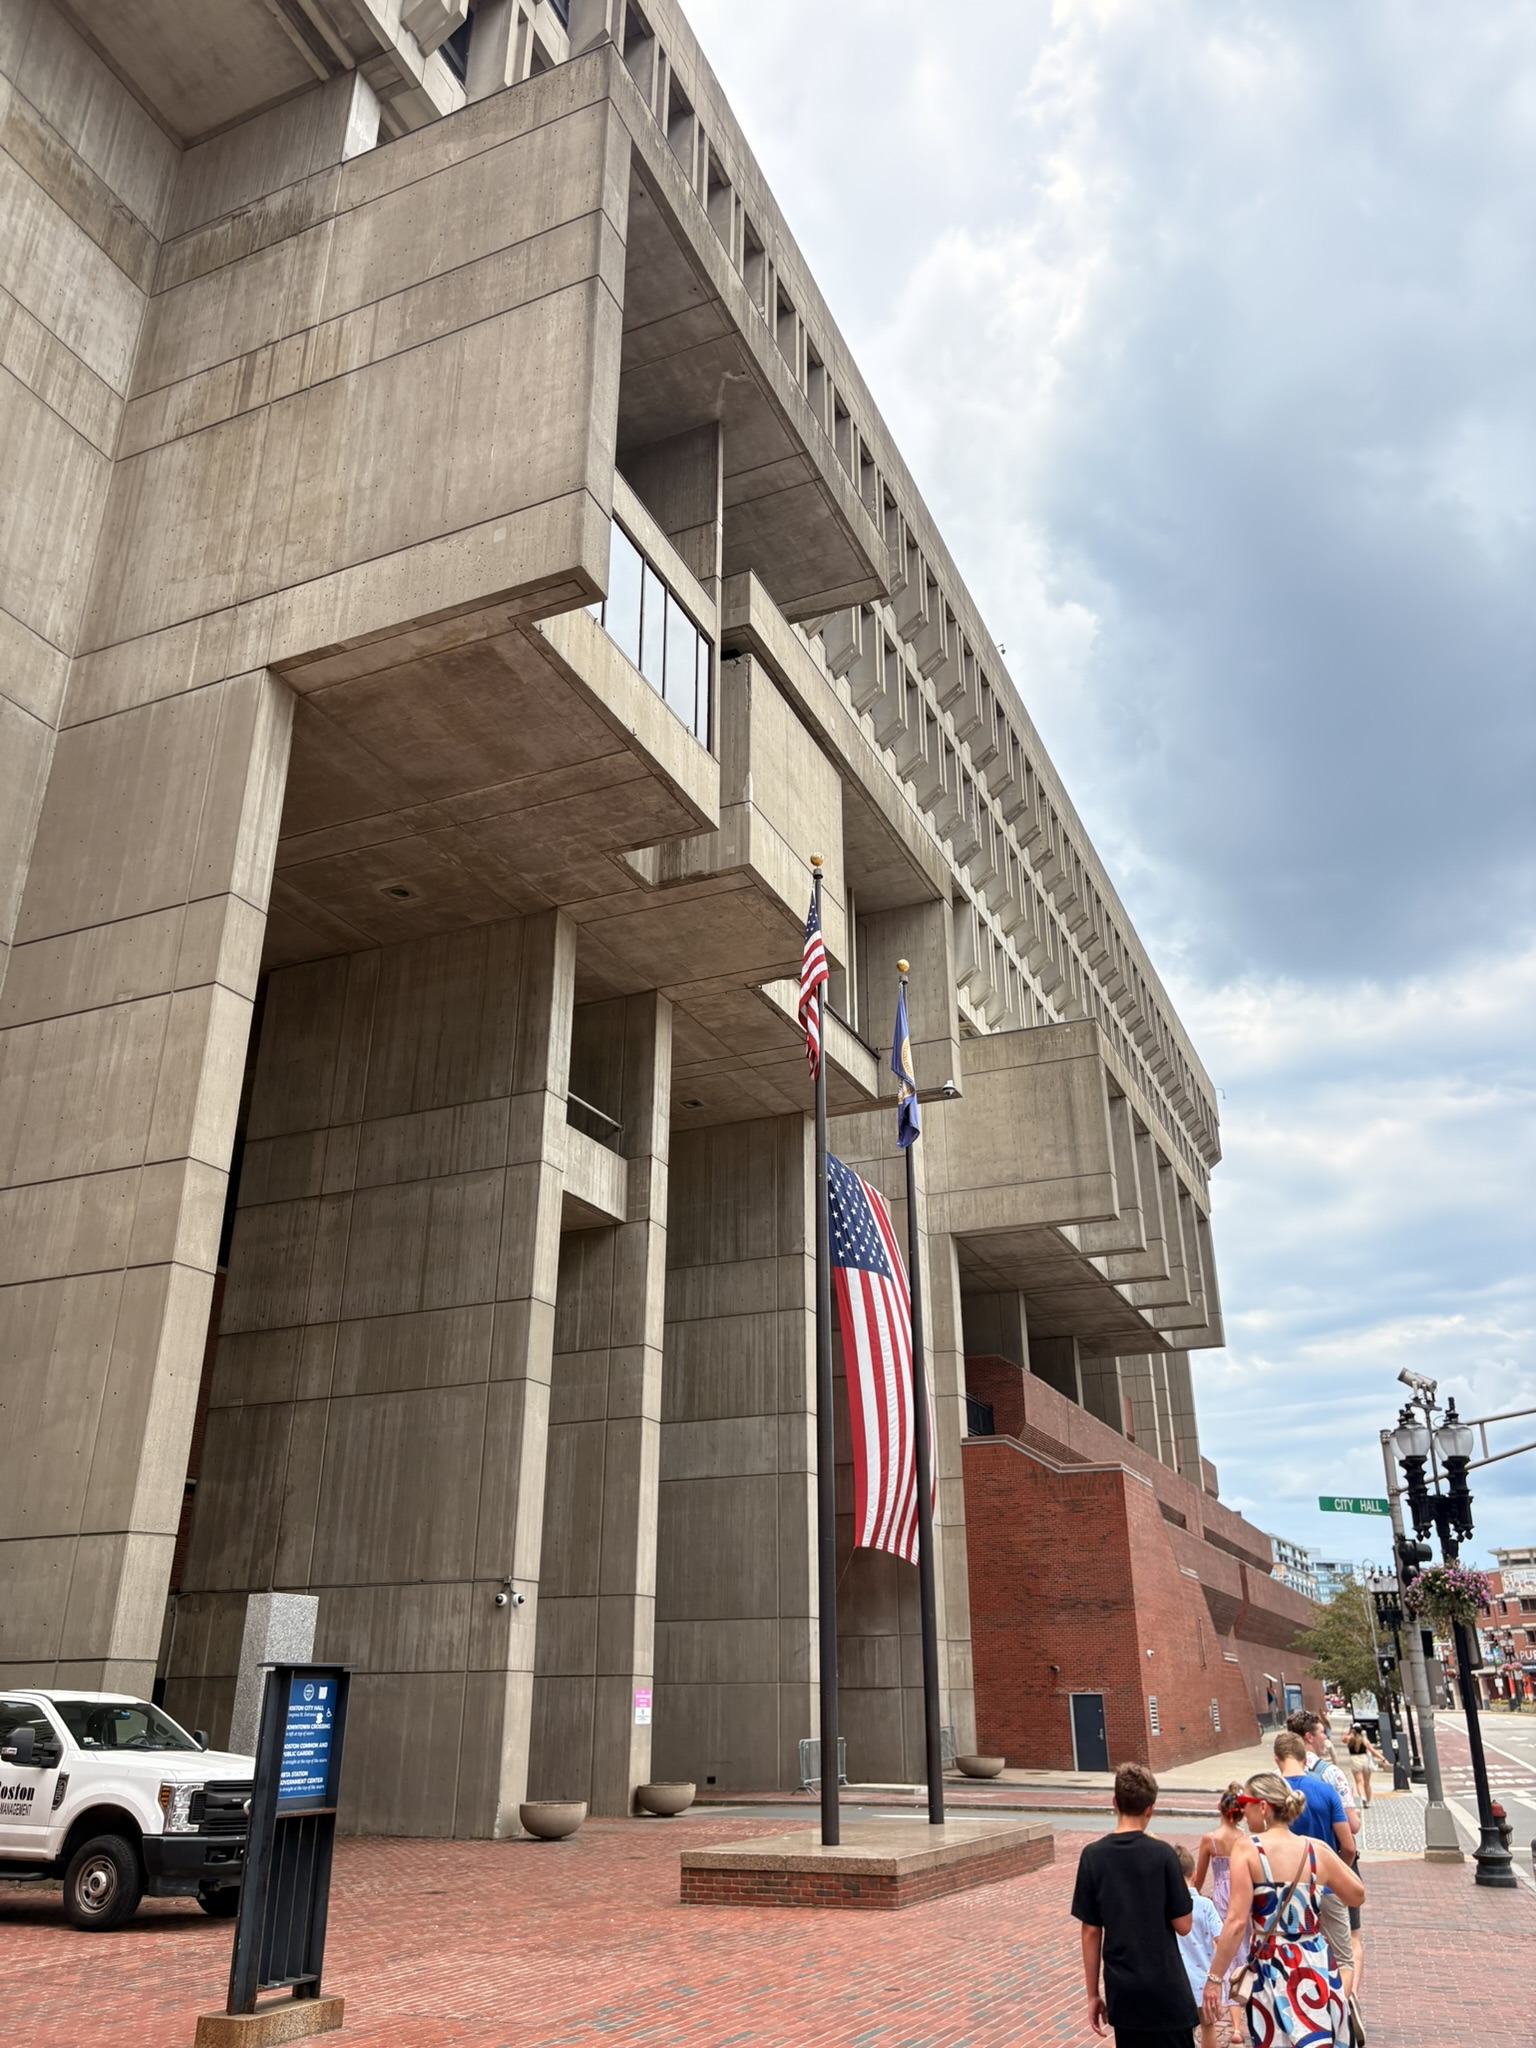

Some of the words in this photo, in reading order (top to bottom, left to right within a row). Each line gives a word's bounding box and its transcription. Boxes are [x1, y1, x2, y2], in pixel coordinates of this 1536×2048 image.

[1334, 1498, 1353, 1511] CITY
[1360, 1500, 1382, 1512] HALL
[0, 1780, 35, 1801] oston
